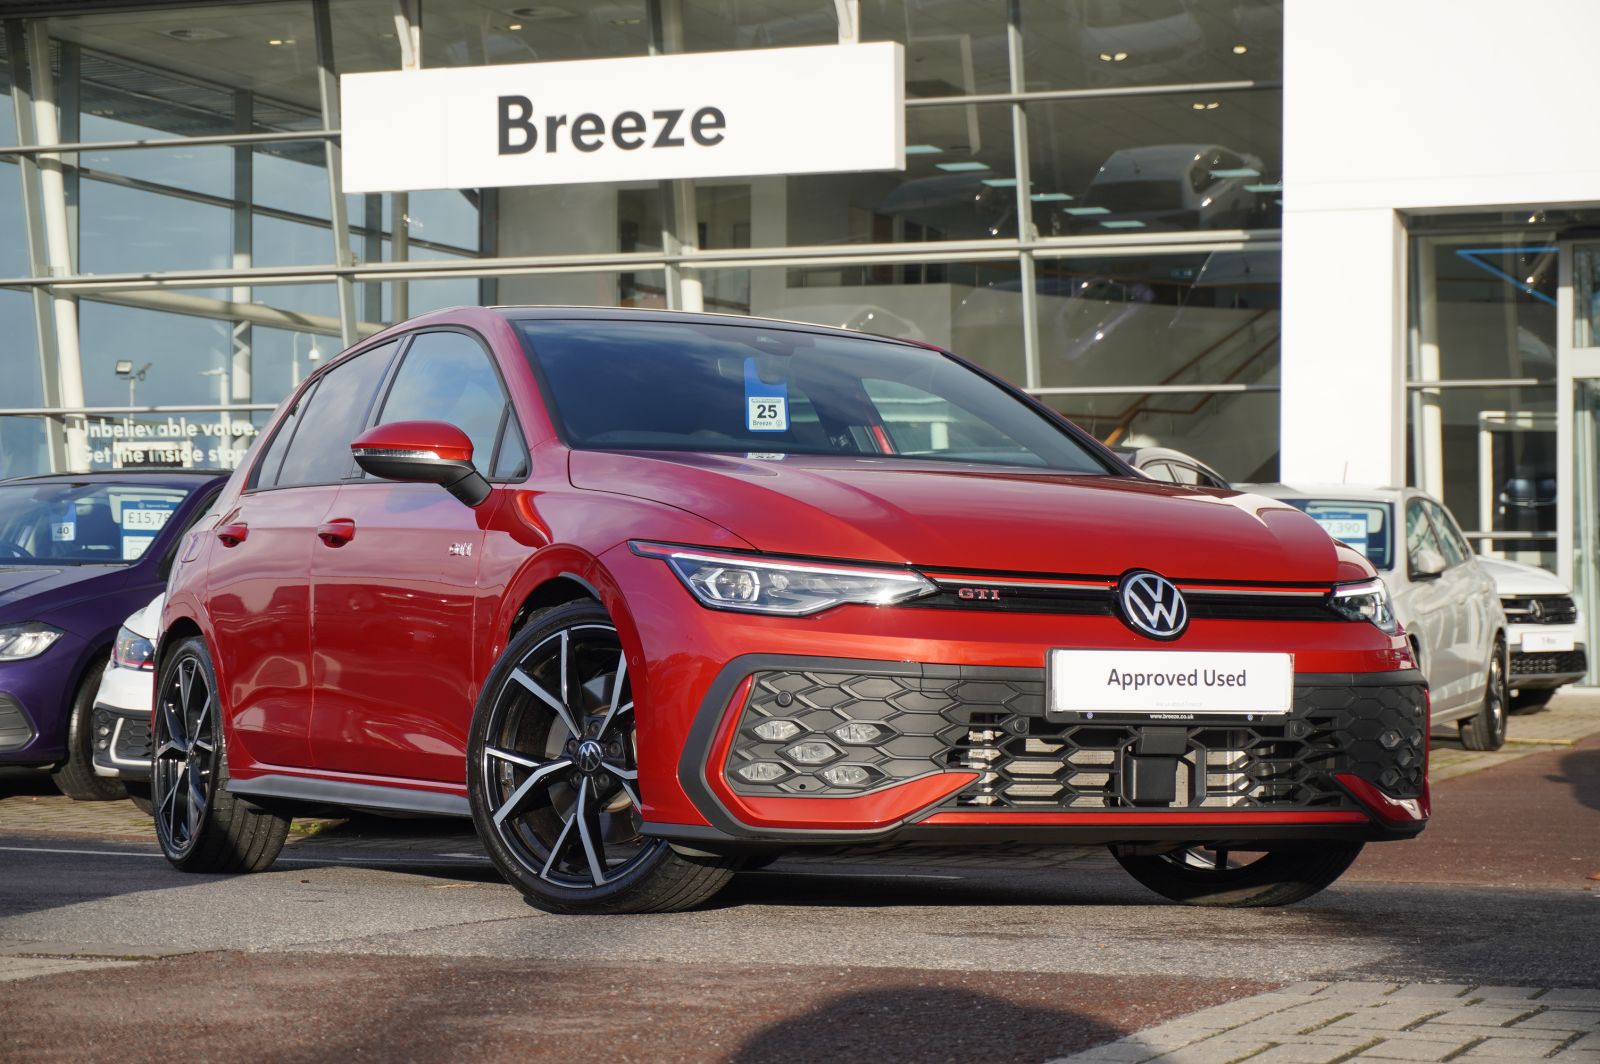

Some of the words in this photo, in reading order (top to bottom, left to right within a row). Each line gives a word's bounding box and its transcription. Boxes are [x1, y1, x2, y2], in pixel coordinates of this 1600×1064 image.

[498, 95, 726, 155] Breeze
[757, 405, 778, 418] 25
[75, 417, 196, 437] Unbelievable
[202, 417, 259, 436] value.
[115, 447, 144, 463] the
[150, 446, 203, 462] inside
[209, 447, 248, 463] stor
[57, 526, 69, 535] 40
[959, 588, 1000, 600] GTI
[1107, 668, 1198, 690] Approved
[1203, 669, 1247, 687] Used
